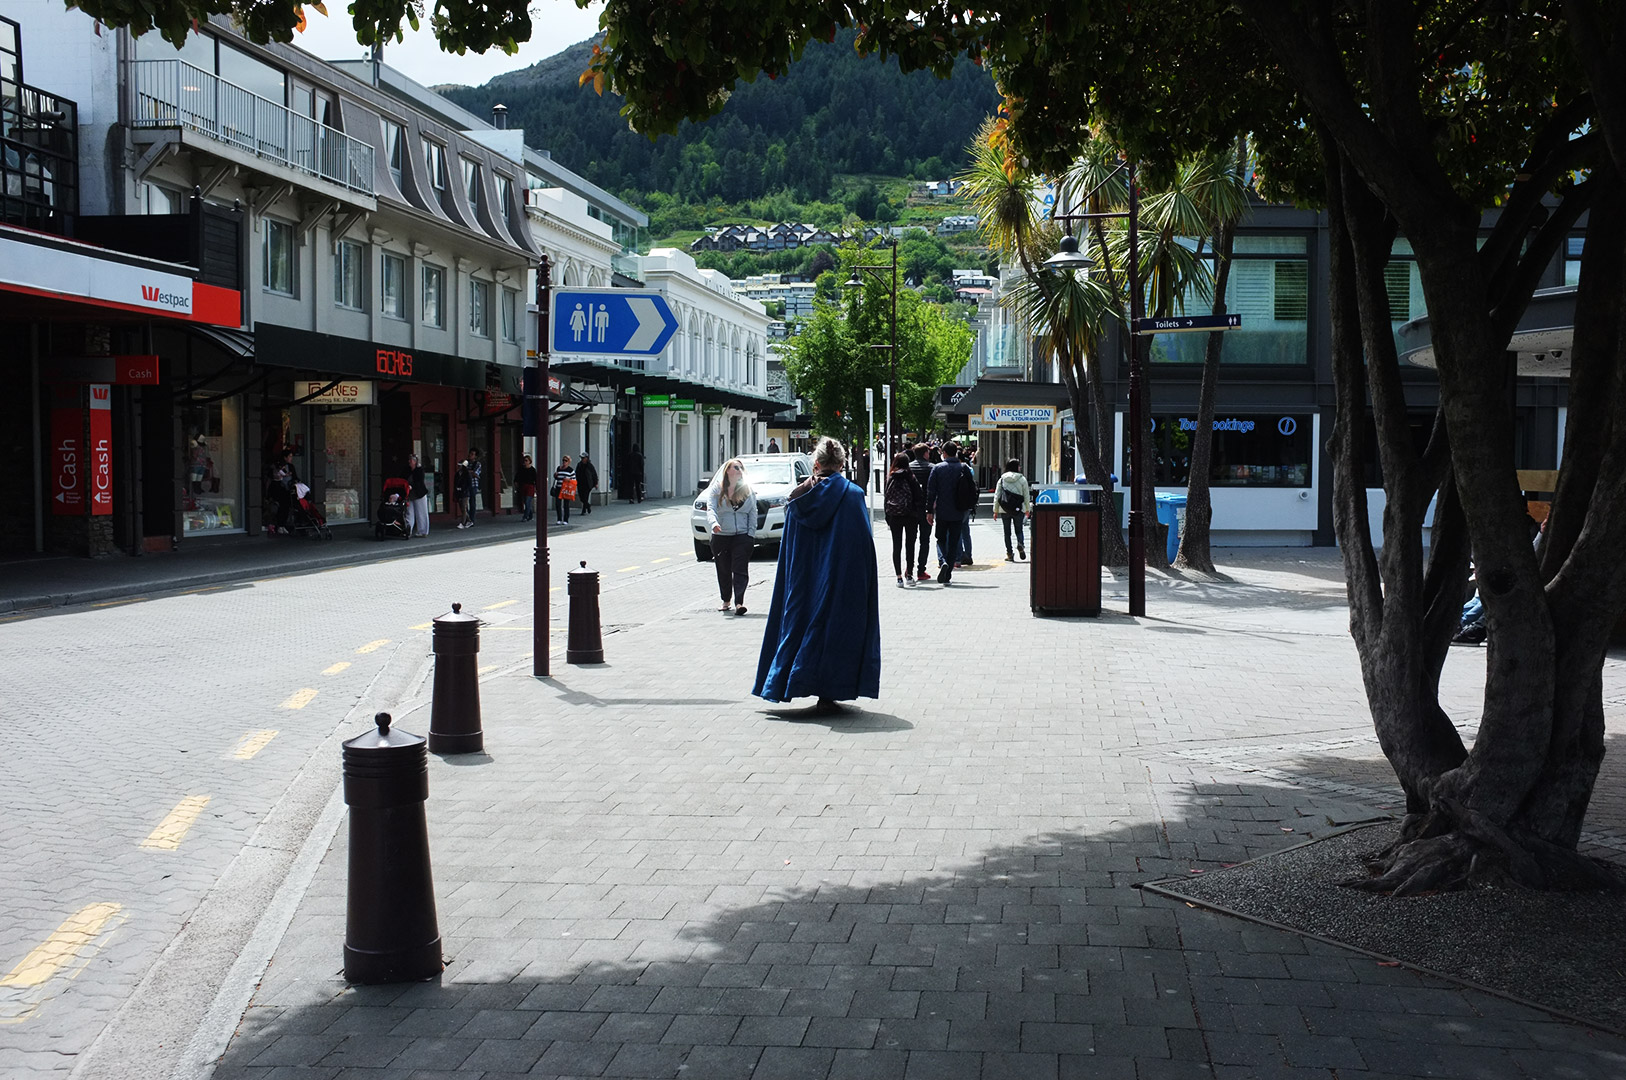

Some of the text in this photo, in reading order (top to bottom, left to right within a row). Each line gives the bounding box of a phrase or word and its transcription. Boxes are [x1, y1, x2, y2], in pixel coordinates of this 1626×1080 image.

[141, 284, 190, 308] Westpac
[1155, 320, 1180, 329] Toilets
[128, 368, 153, 379] Cash
[1000, 408, 1051, 417] RECEPTION
[1178, 417, 1255, 434] Tou ookings
[58, 439, 77, 490] Cash
[95, 439, 109, 490] Cash
